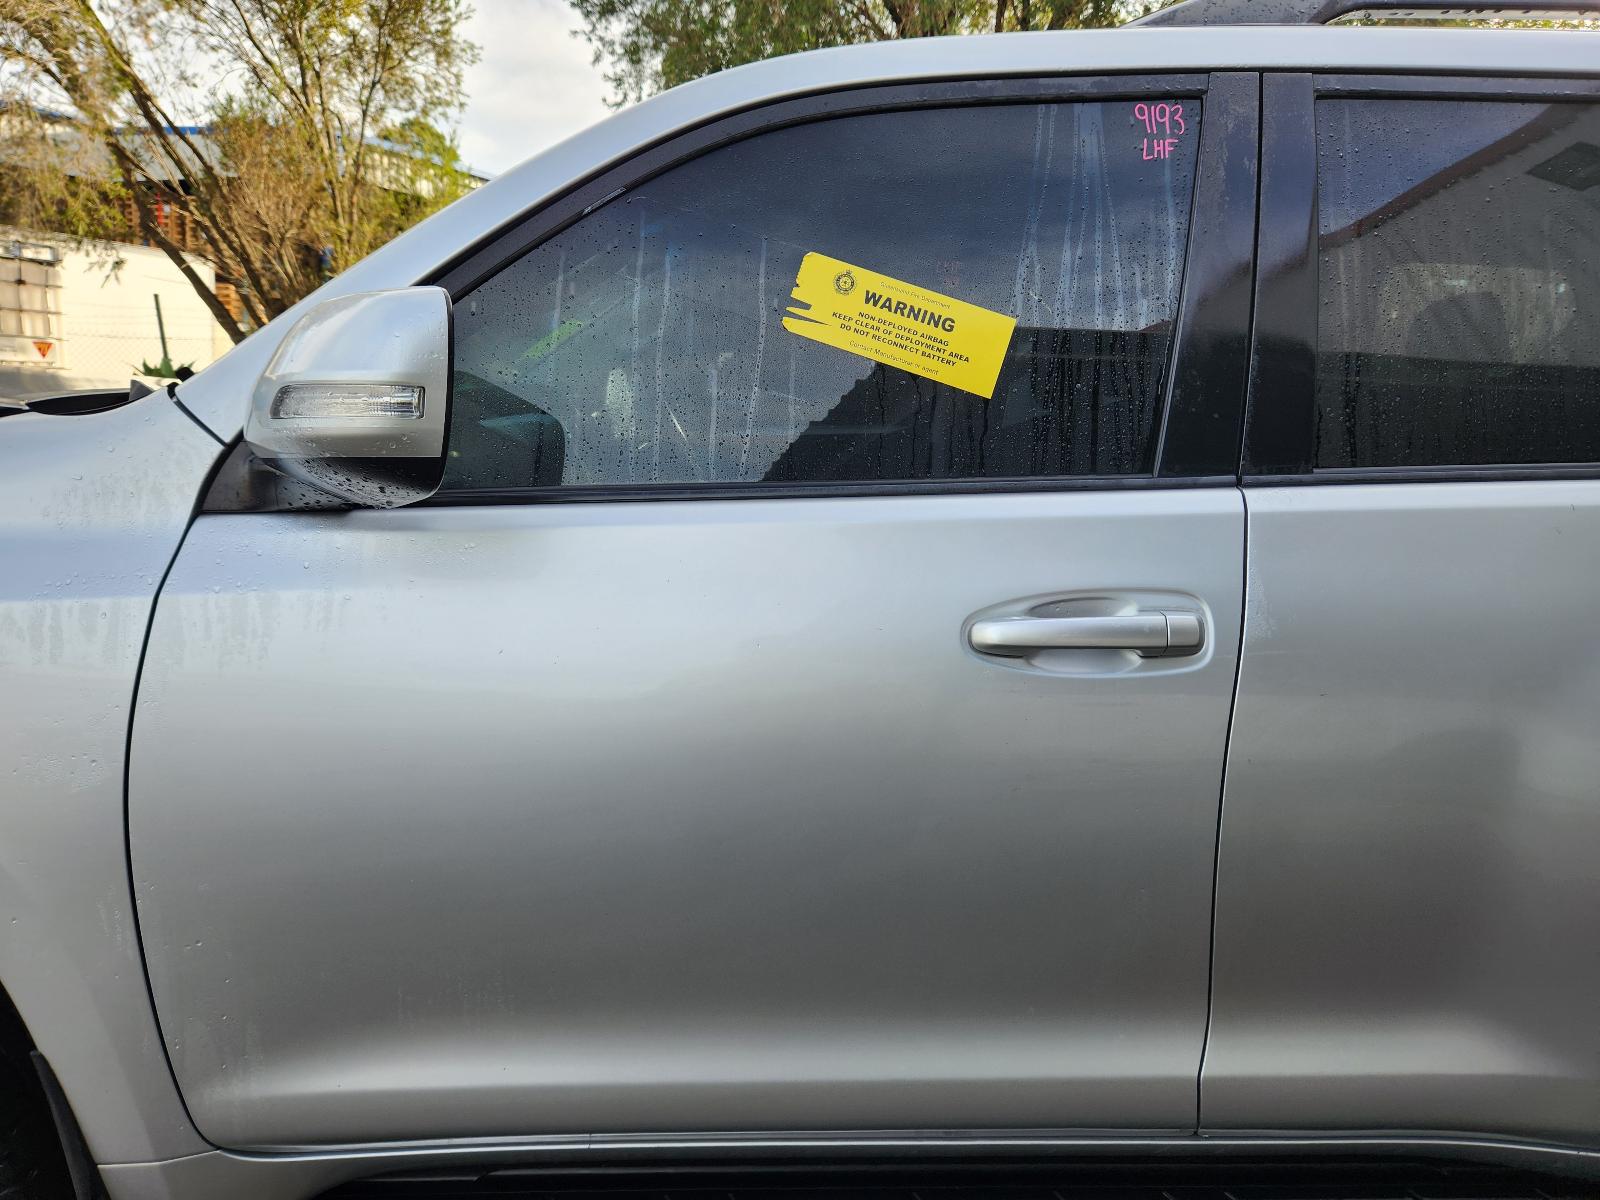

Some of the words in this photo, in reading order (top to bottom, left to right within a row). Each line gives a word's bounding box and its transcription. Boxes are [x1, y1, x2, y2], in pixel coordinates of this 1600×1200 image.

[1134, 103, 1185, 135] 9193
[1142, 138, 1179, 160] LHF
[858, 311, 918, 336] NON-DEPLOYED
[920, 332, 949, 347] AIRBAG
[864, 289, 956, 333] WARNING
[832, 311, 854, 323] KEEP
[855, 319, 881, 333] CLEAR
[882, 328, 893, 337] OF
[895, 332, 948, 355] DEPLOYMENT
[948, 351, 970, 363] AREA
[840, 323, 852, 331] DO
[853, 328, 870, 338] NOT
[871, 333, 920, 355] RECONNECT
[921, 350, 957, 367] BATTERY
[849, 340, 873, 353] Contact
[922, 365, 939, 376] agent
